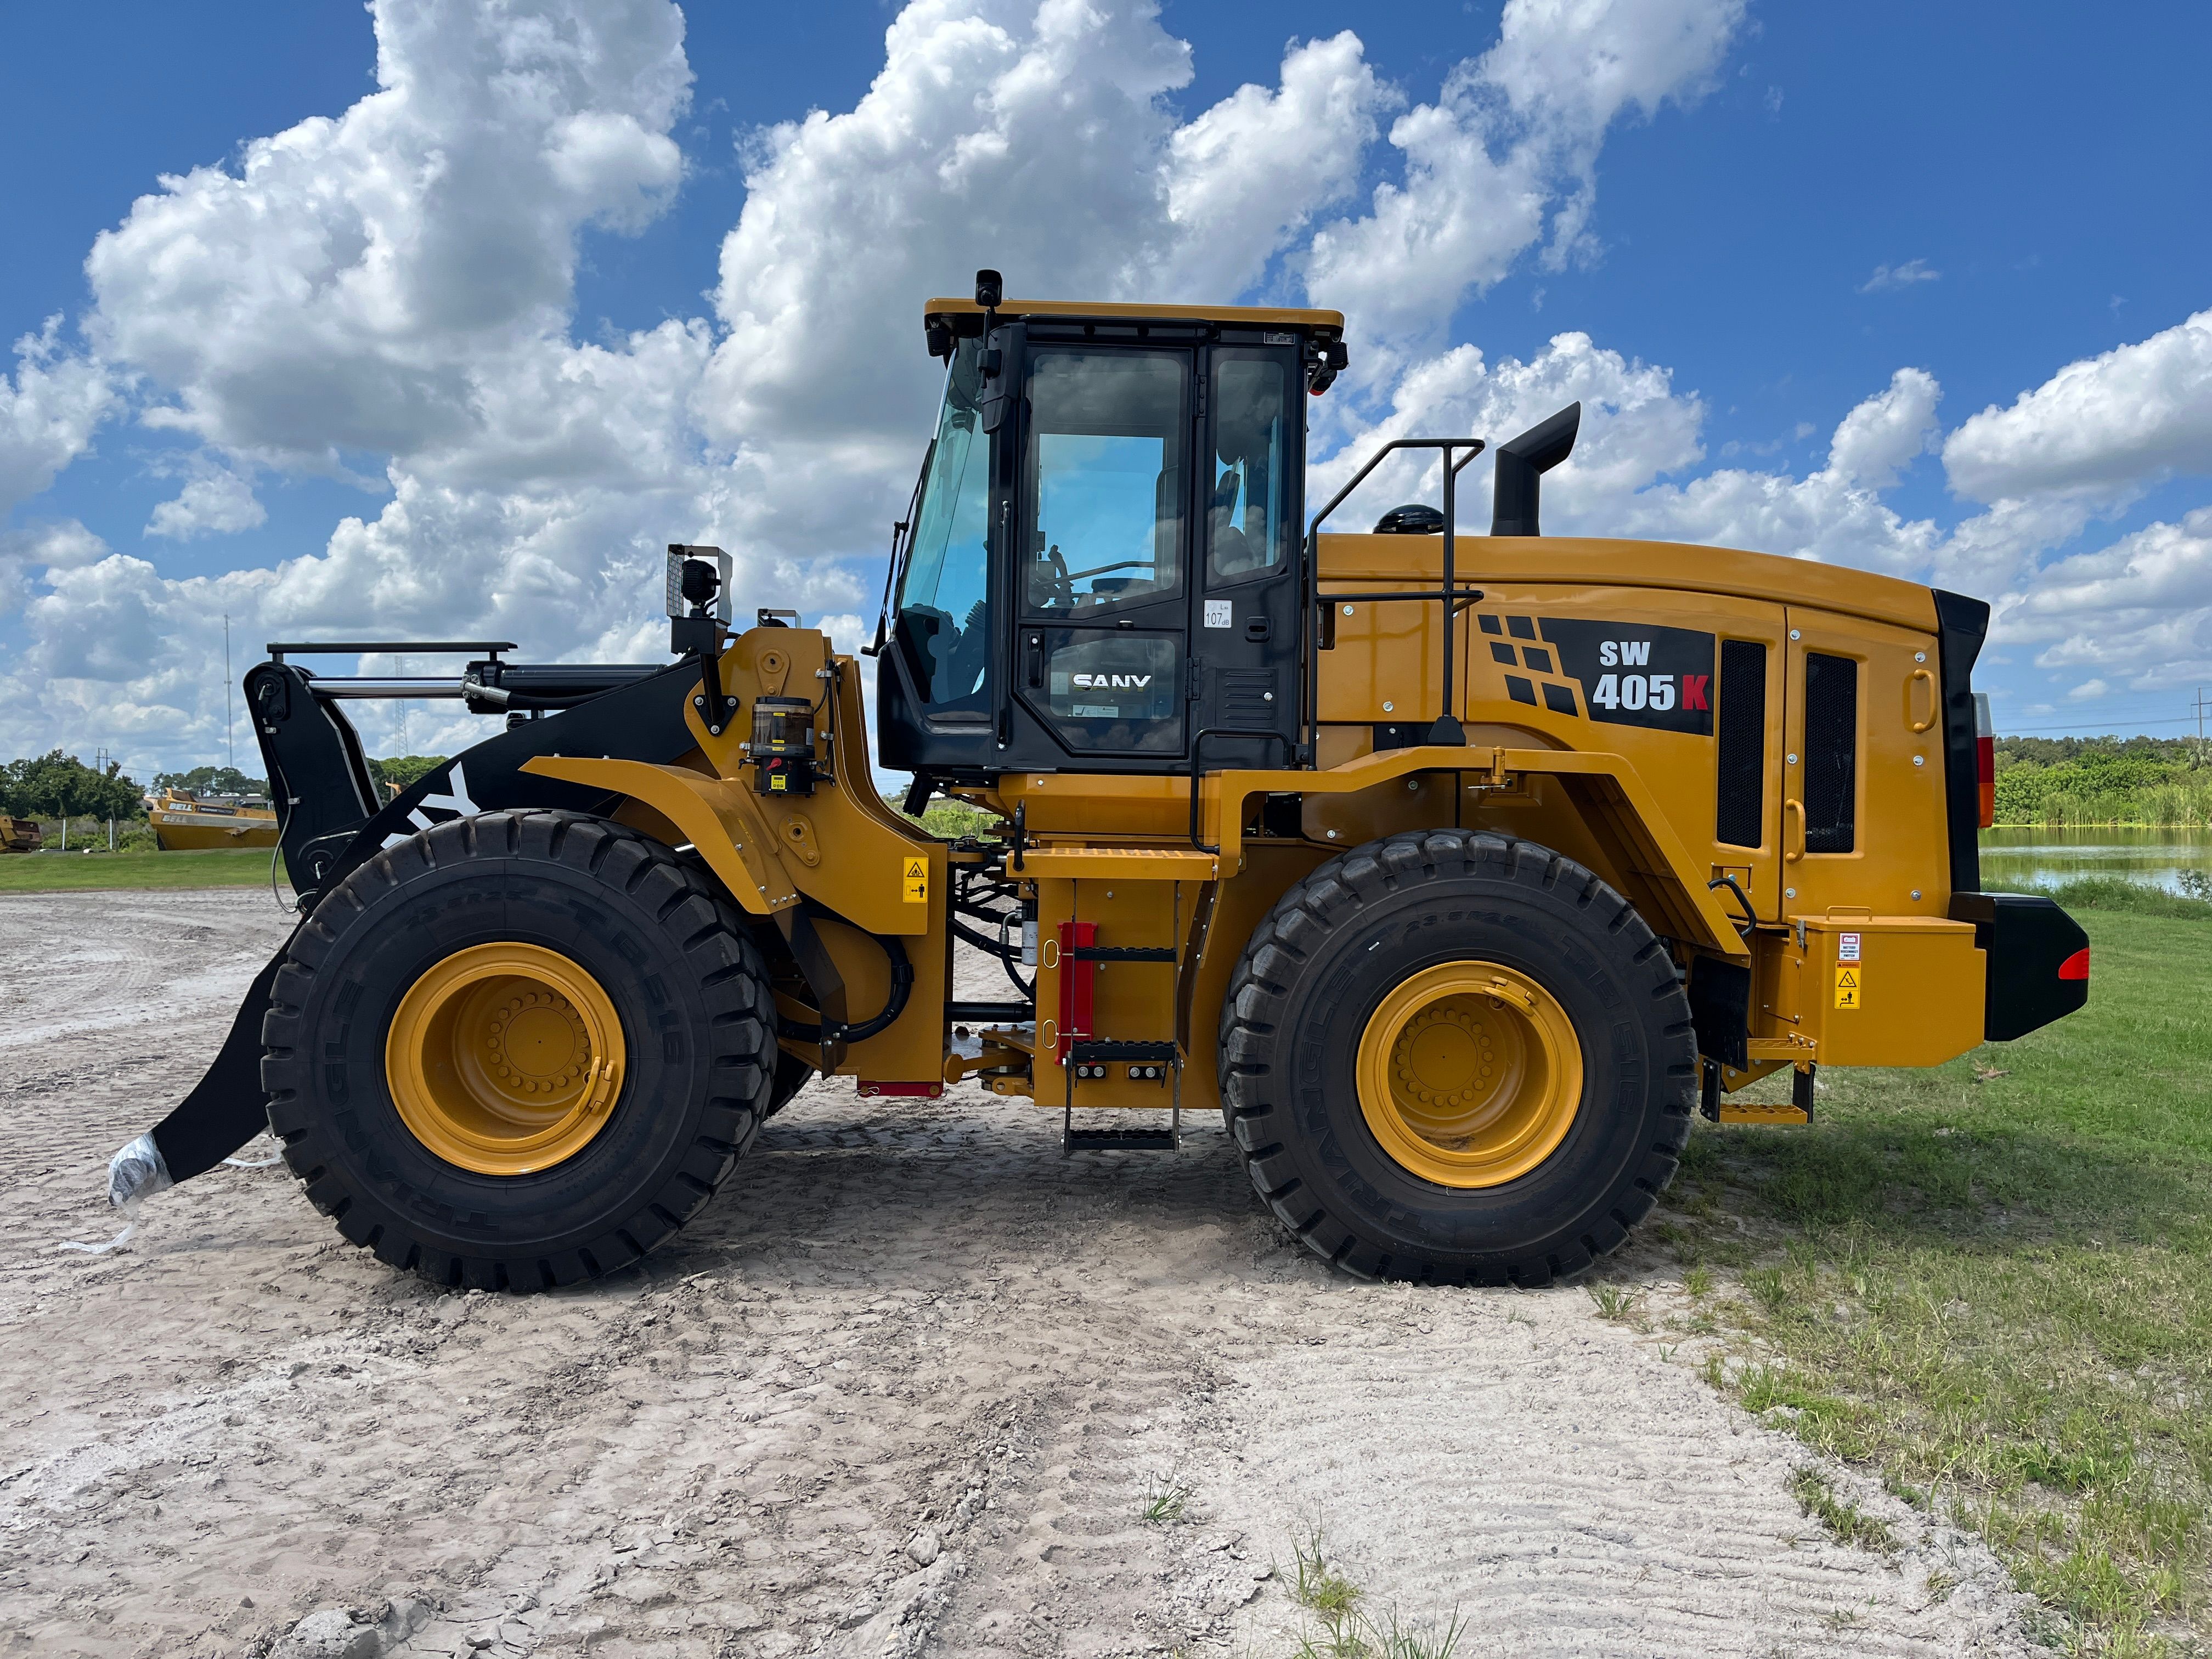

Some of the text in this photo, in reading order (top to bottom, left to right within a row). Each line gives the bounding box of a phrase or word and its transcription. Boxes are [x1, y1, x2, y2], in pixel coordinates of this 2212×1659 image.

[1600, 641, 1651, 667] SW
[1073, 674, 1152, 692] SANY
[168, 803, 193, 811] BELL
[323, 978, 500, 1233] TRIANGLE
[1300, 964, 1430, 1237] TRIANGLE
